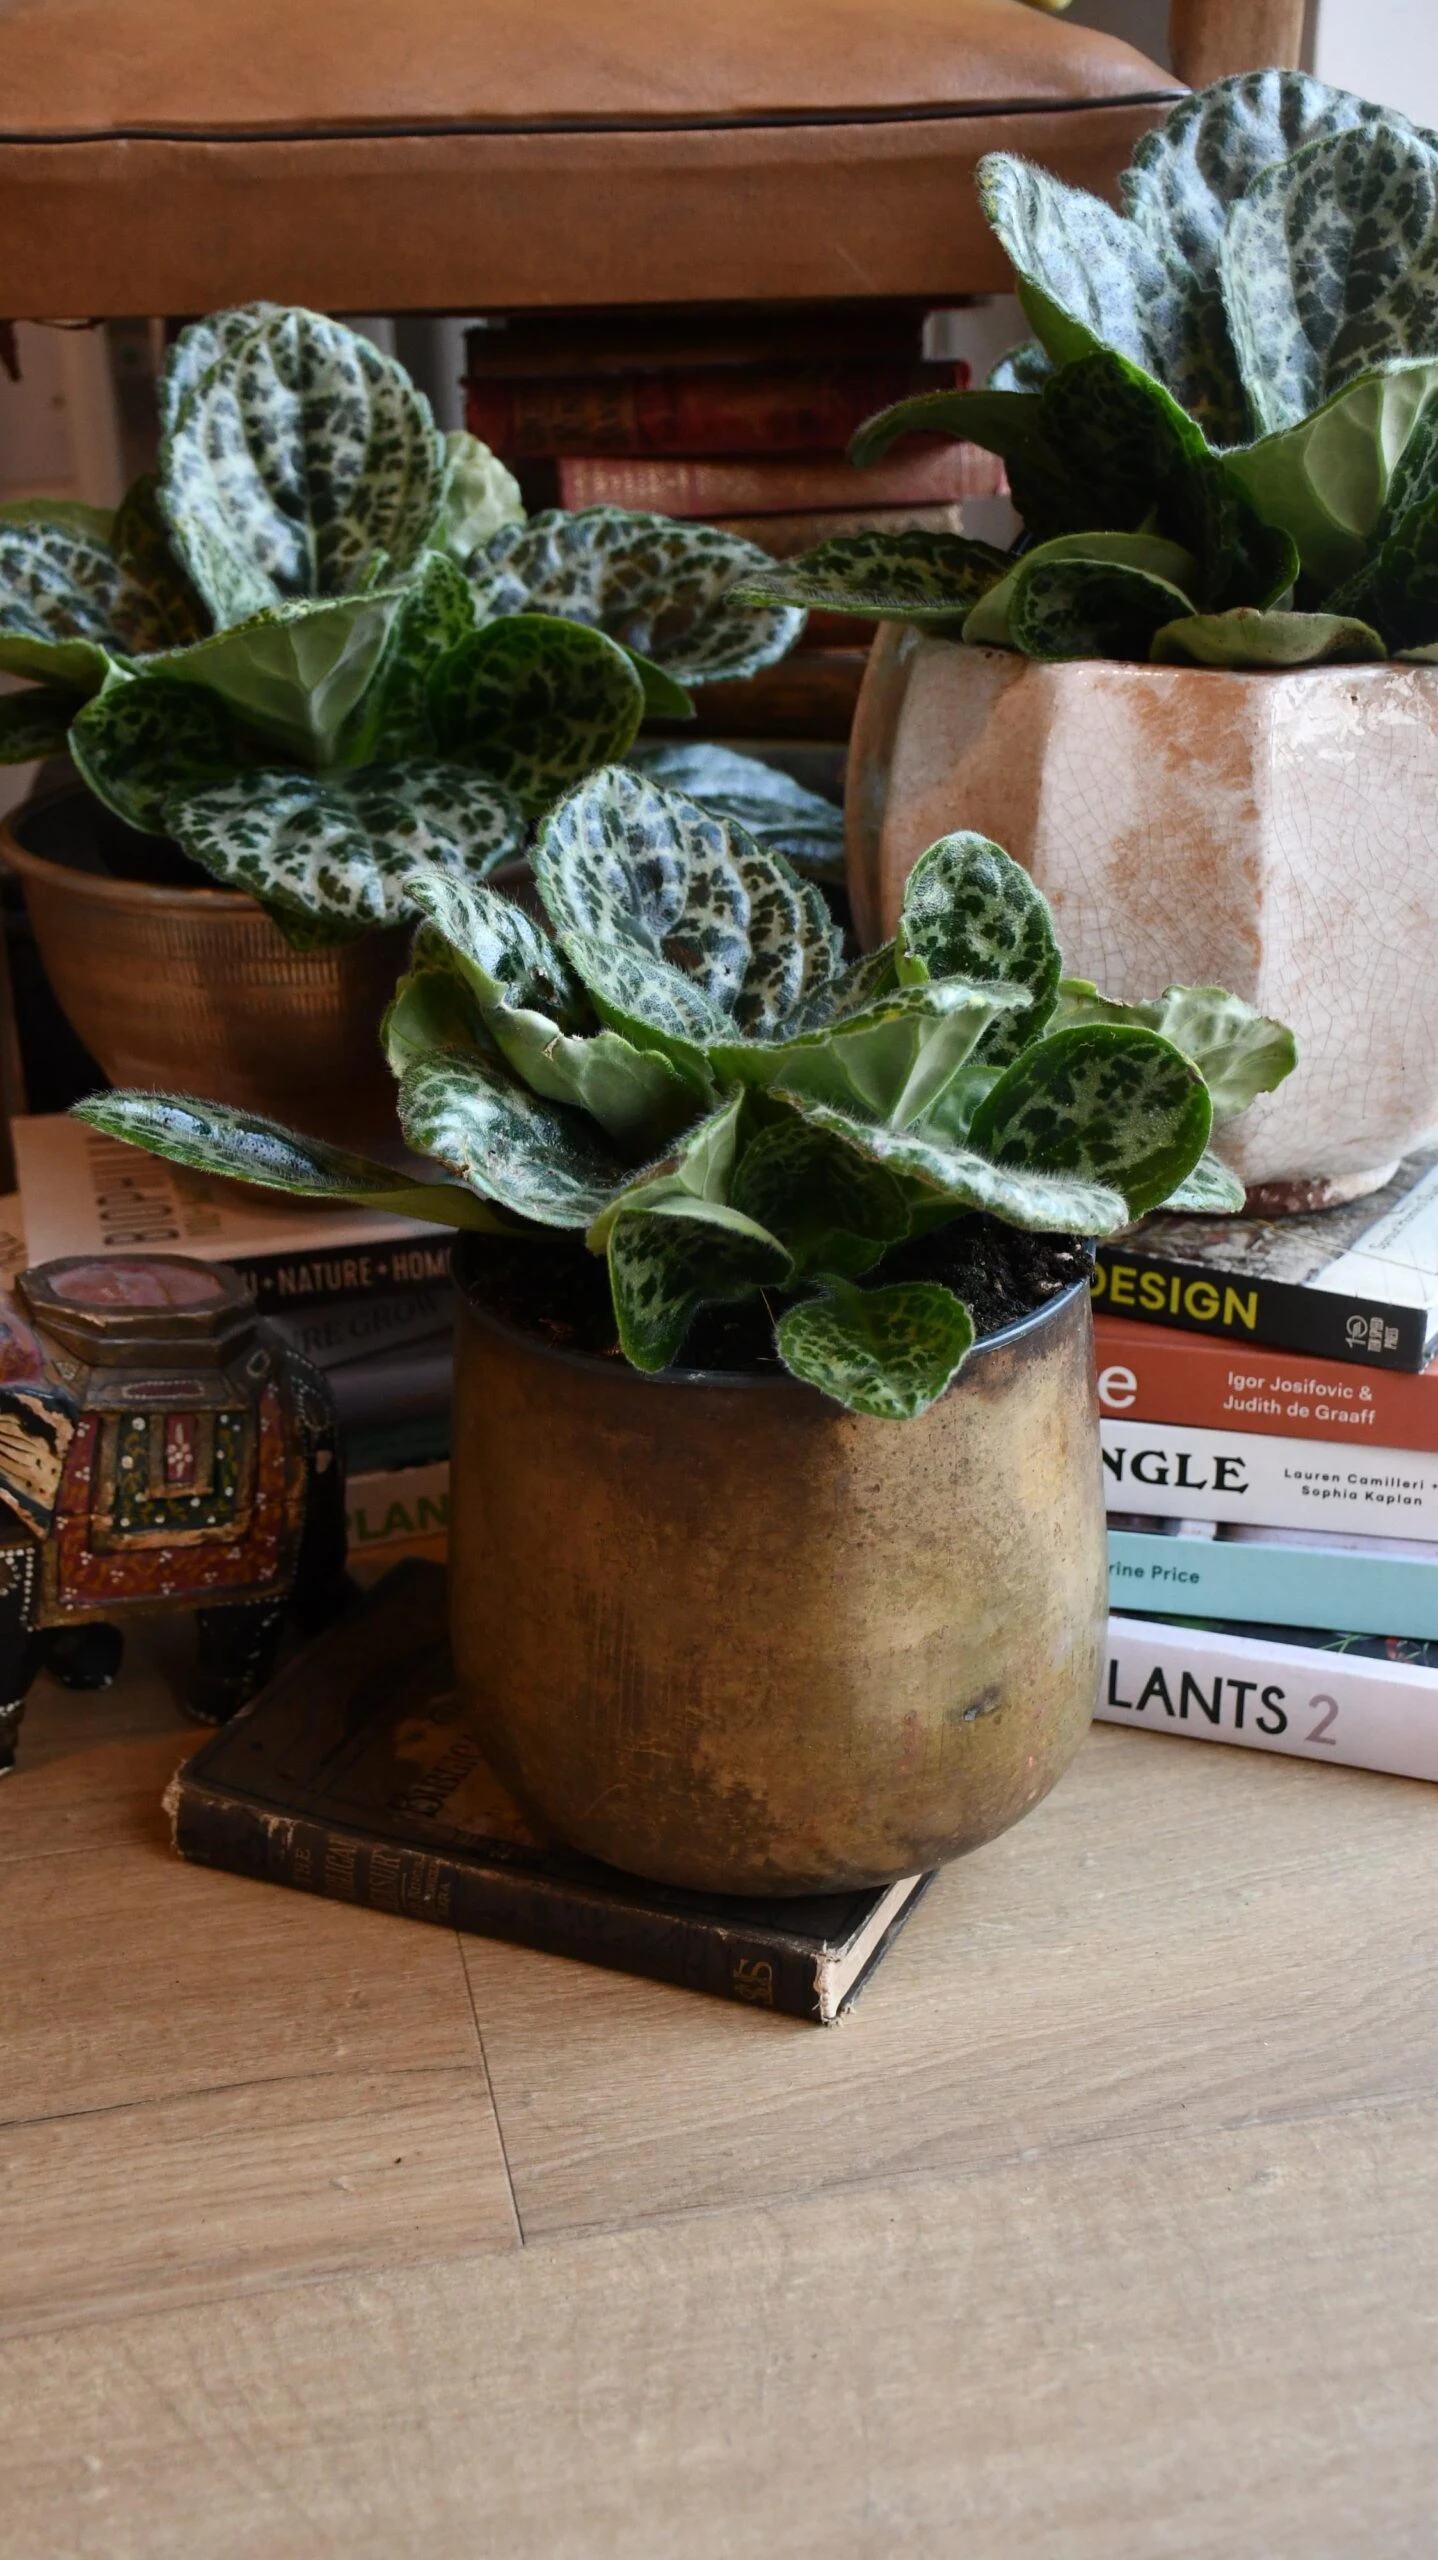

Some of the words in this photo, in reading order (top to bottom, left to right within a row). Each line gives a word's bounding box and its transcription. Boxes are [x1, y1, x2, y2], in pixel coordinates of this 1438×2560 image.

[278, 1256, 374, 1297] NATURE
[1097, 1365, 1138, 1408] e
[1227, 1371, 1266, 1392] Igor
[1270, 1376, 1354, 1400] Josifovic
[1359, 1383, 1373, 1401] &
[1223, 1395, 1281, 1415] Judith
[1286, 1400, 1309, 1418] de
[1315, 1406, 1376, 1425] Graaff
[1102, 1448, 1250, 1494] NGLE
[1284, 1468, 1341, 1483] Lauren
[1347, 1472, 1425, 1490] Camilleri
[1301, 1486, 1358, 1501] Sophia
[1364, 1490, 1424, 1506] Kaplan
[343, 1493, 451, 1540] LAN
[1109, 1562, 1145, 1579] rine
[1151, 1565, 1201, 1585] Price
[1108, 1659, 1288, 1735] LANTS
[1305, 1694, 1339, 1746] 2
